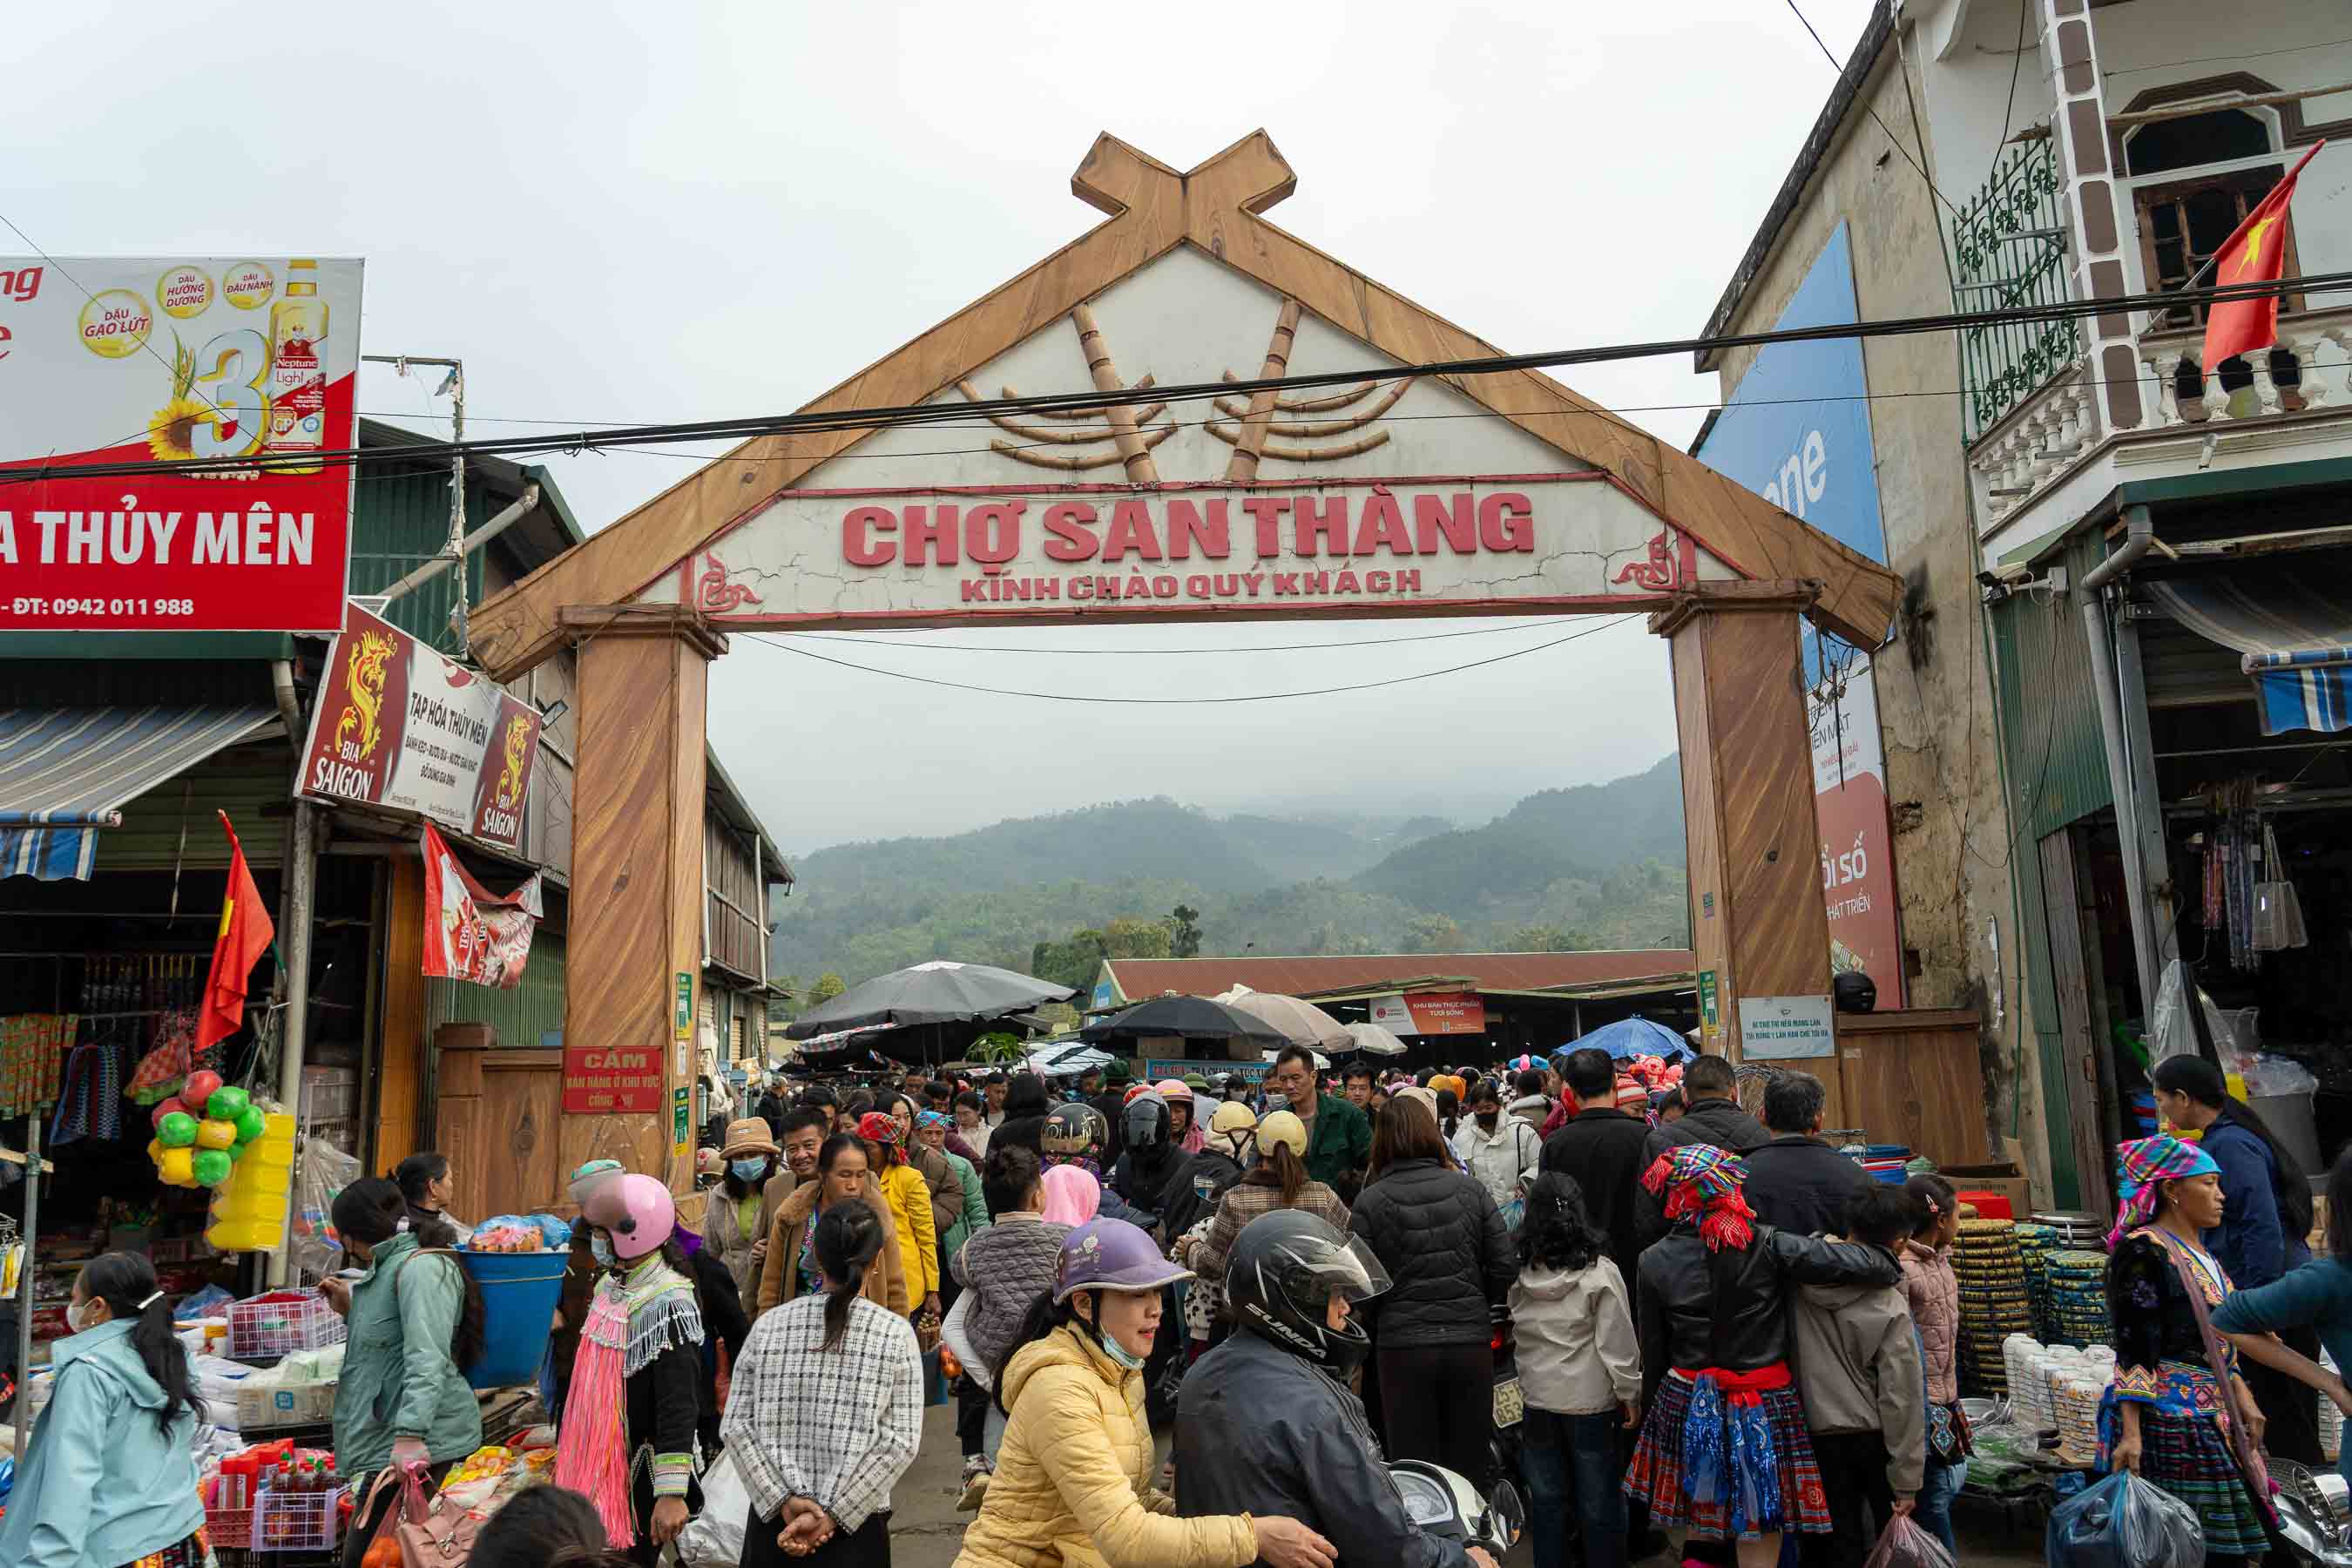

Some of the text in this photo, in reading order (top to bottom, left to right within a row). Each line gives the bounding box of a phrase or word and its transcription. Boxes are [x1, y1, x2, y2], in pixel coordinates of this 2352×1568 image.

[276, 357, 319, 369] Neptune
[33, 494, 181, 565] THỦY
[192, 501, 314, 565] MÊN
[842, 483, 1535, 576] CHỢ SAN THÀNG
[961, 559, 1422, 602] KÍNH CHÀO QUÝ KHÁCH
[13, 598, 49, 616] ĐT:
[53, 598, 105, 616] 0942
[110, 598, 151, 616] 011
[154, 598, 194, 616] 988
[409, 692, 429, 725] TẠP
[448, 708, 470, 740] THỦY
[341, 740, 360, 764] BIA
[313, 757, 375, 801] SAIGON
[481, 808, 517, 838] SAIGON
[498, 794, 510, 809] BIA
[1839, 830, 1868, 885] SỐ
[585, 1050, 648, 1069] CẤM
[1244, 1302, 1327, 1359] SUNDA
